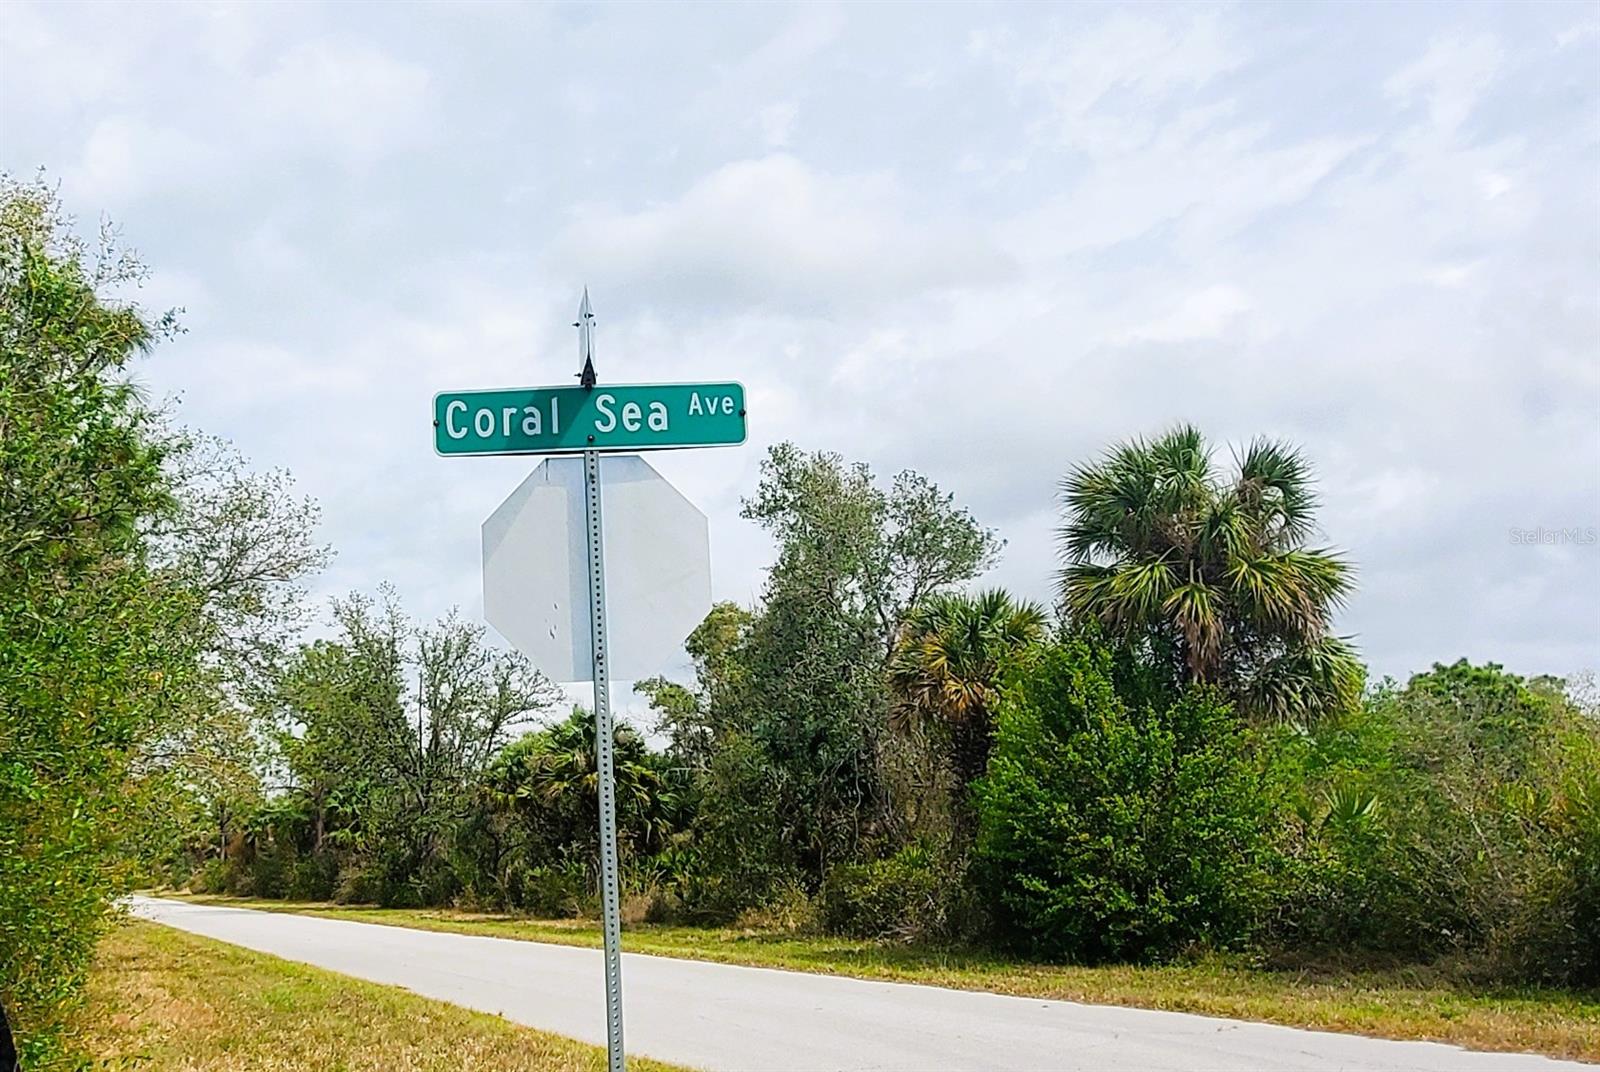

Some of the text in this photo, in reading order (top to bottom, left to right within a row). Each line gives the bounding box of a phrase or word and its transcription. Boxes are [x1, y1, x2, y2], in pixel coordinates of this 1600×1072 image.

[446, 392, 735, 439] Coral Sea Ave
